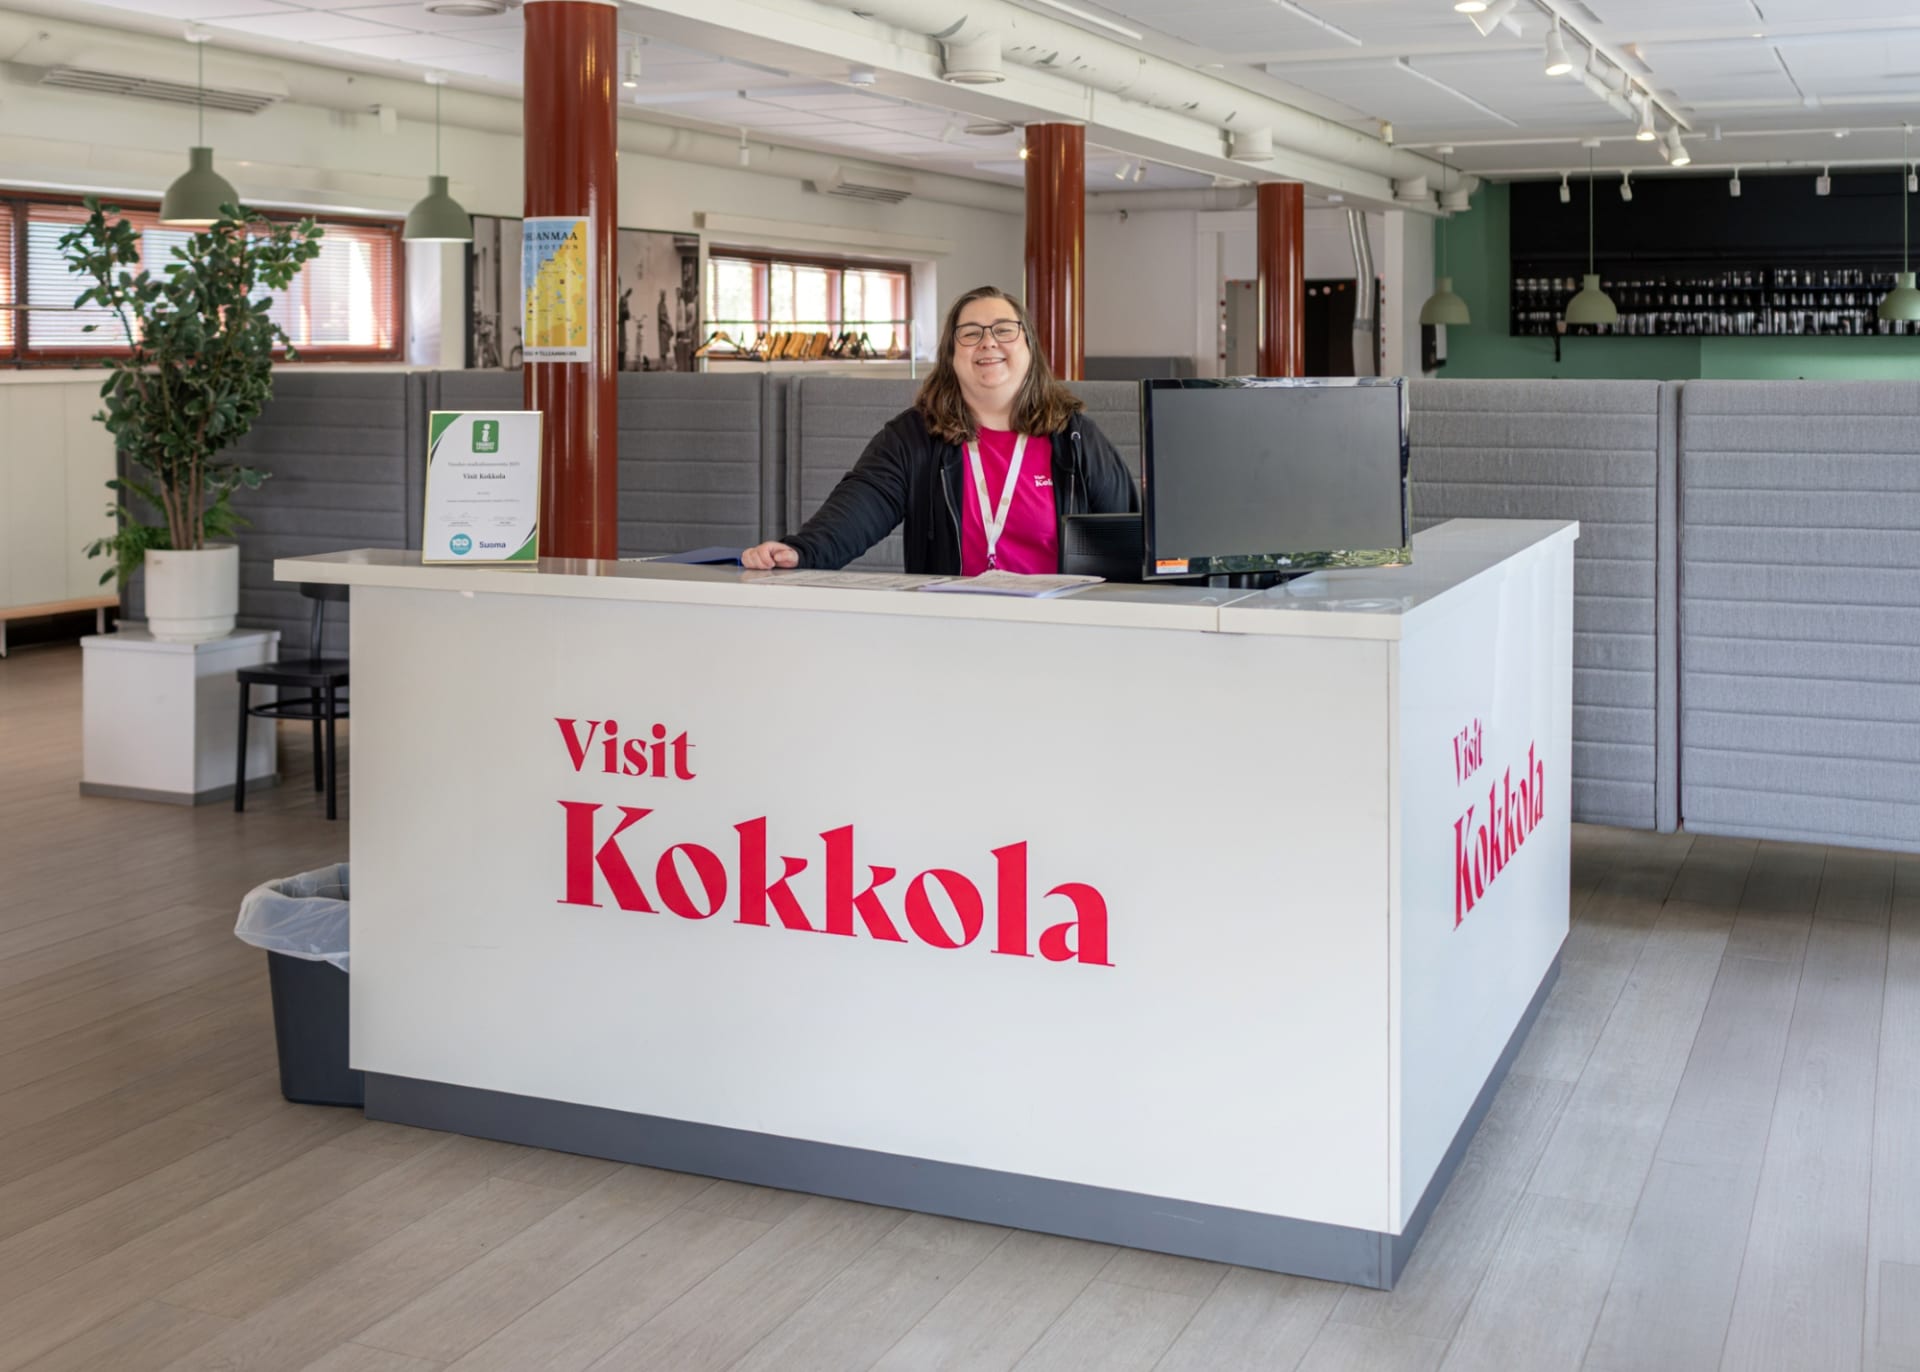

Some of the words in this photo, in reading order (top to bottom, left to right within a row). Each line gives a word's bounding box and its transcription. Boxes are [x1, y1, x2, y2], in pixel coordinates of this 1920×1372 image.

[480, 472, 506, 480] Kokkola
[555, 718, 696, 781] Visit
[1453, 717, 1483, 788] Visit
[1453, 738, 1544, 932] Kokkola
[558, 800, 1115, 967] Kokkola
